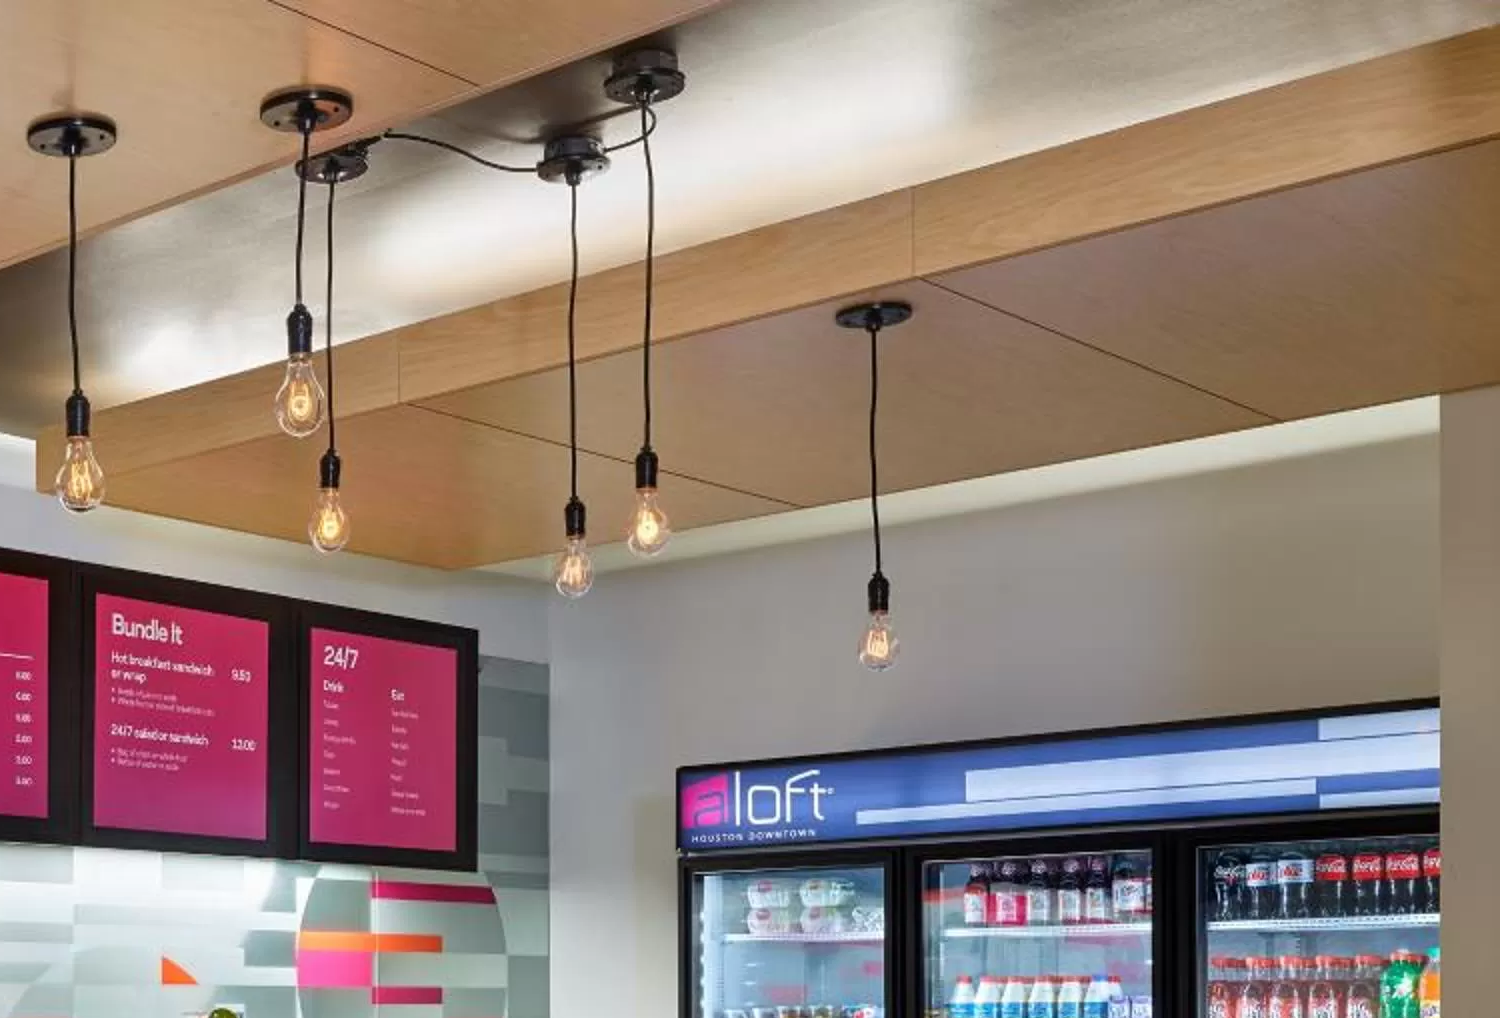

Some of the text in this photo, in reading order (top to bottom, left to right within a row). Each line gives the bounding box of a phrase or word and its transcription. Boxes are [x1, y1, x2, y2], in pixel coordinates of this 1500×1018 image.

[111, 613, 184, 645] Bundle It
[111, 651, 128, 665] Hot
[323, 645, 359, 670] 24/7
[683, 769, 826, 829] aloft
[692, 829, 816, 843] HOUSTON DOWNTOWN
